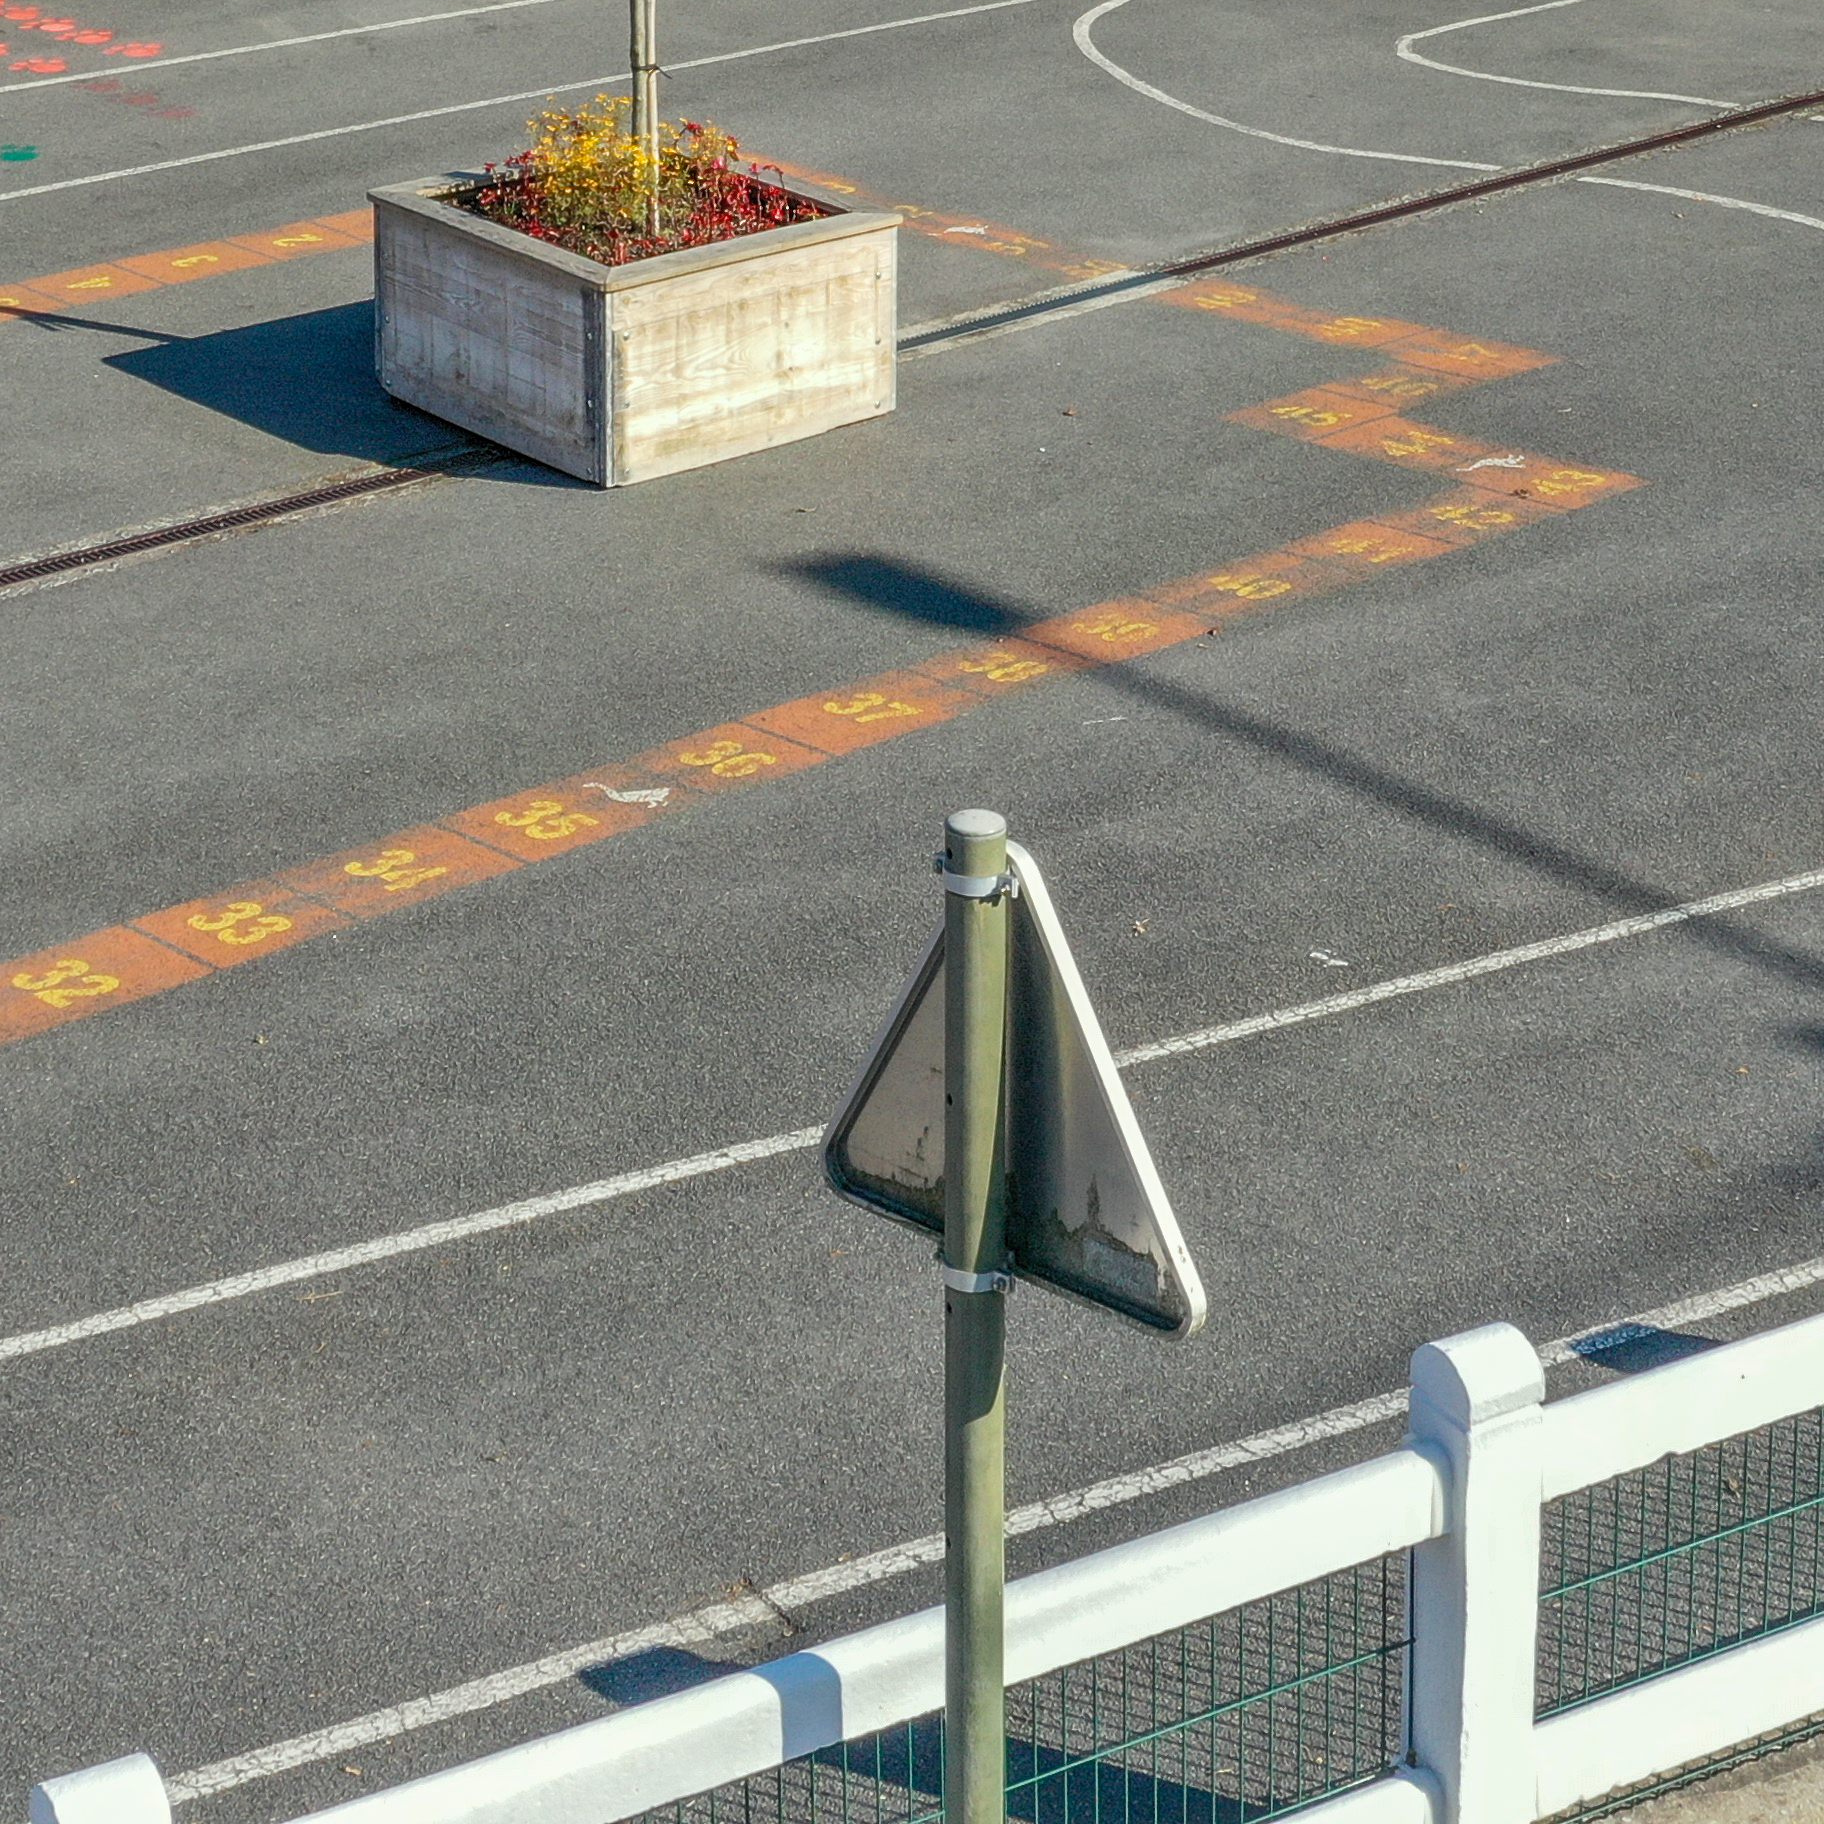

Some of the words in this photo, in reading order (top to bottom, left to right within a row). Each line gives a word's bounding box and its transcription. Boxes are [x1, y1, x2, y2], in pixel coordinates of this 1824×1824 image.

[273, 233, 324, 248] 2
[171, 254, 220, 268] 3
[66, 275, 112, 290] 4
[1268, 406, 1353, 427] 45
[1530, 470, 1607, 496] 43
[1428, 504, 1517, 530] 42
[1211, 575, 1293, 601] 40
[957, 651, 1049, 683] 38
[822, 692, 925, 724] 37
[679, 739, 777, 778] 36
[493, 799, 600, 841] 35
[343, 848, 448, 892] 34
[186, 900, 293, 946] 33
[11, 958, 119, 1009] 32
